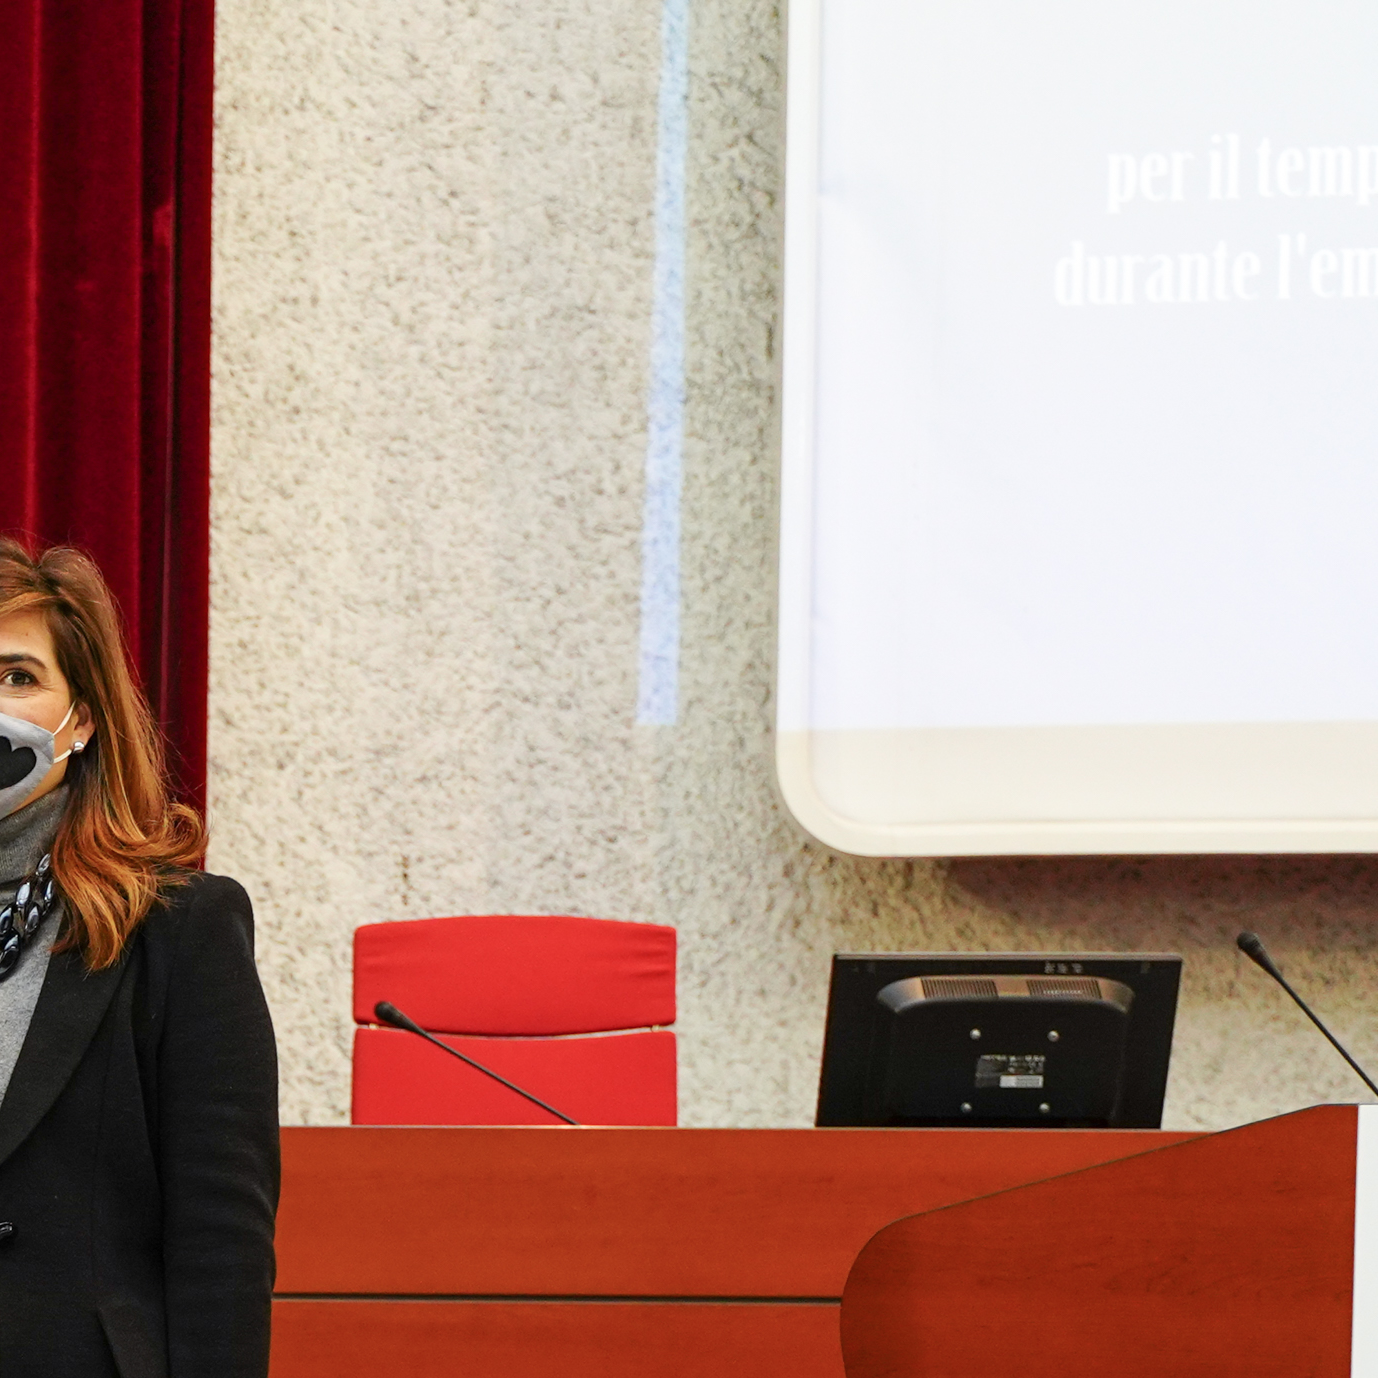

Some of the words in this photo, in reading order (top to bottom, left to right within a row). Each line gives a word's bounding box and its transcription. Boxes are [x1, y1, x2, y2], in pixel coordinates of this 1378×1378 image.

[1106, 151, 1195, 215] per
[1208, 132, 1241, 201] il
[1053, 239, 1262, 306] durante
